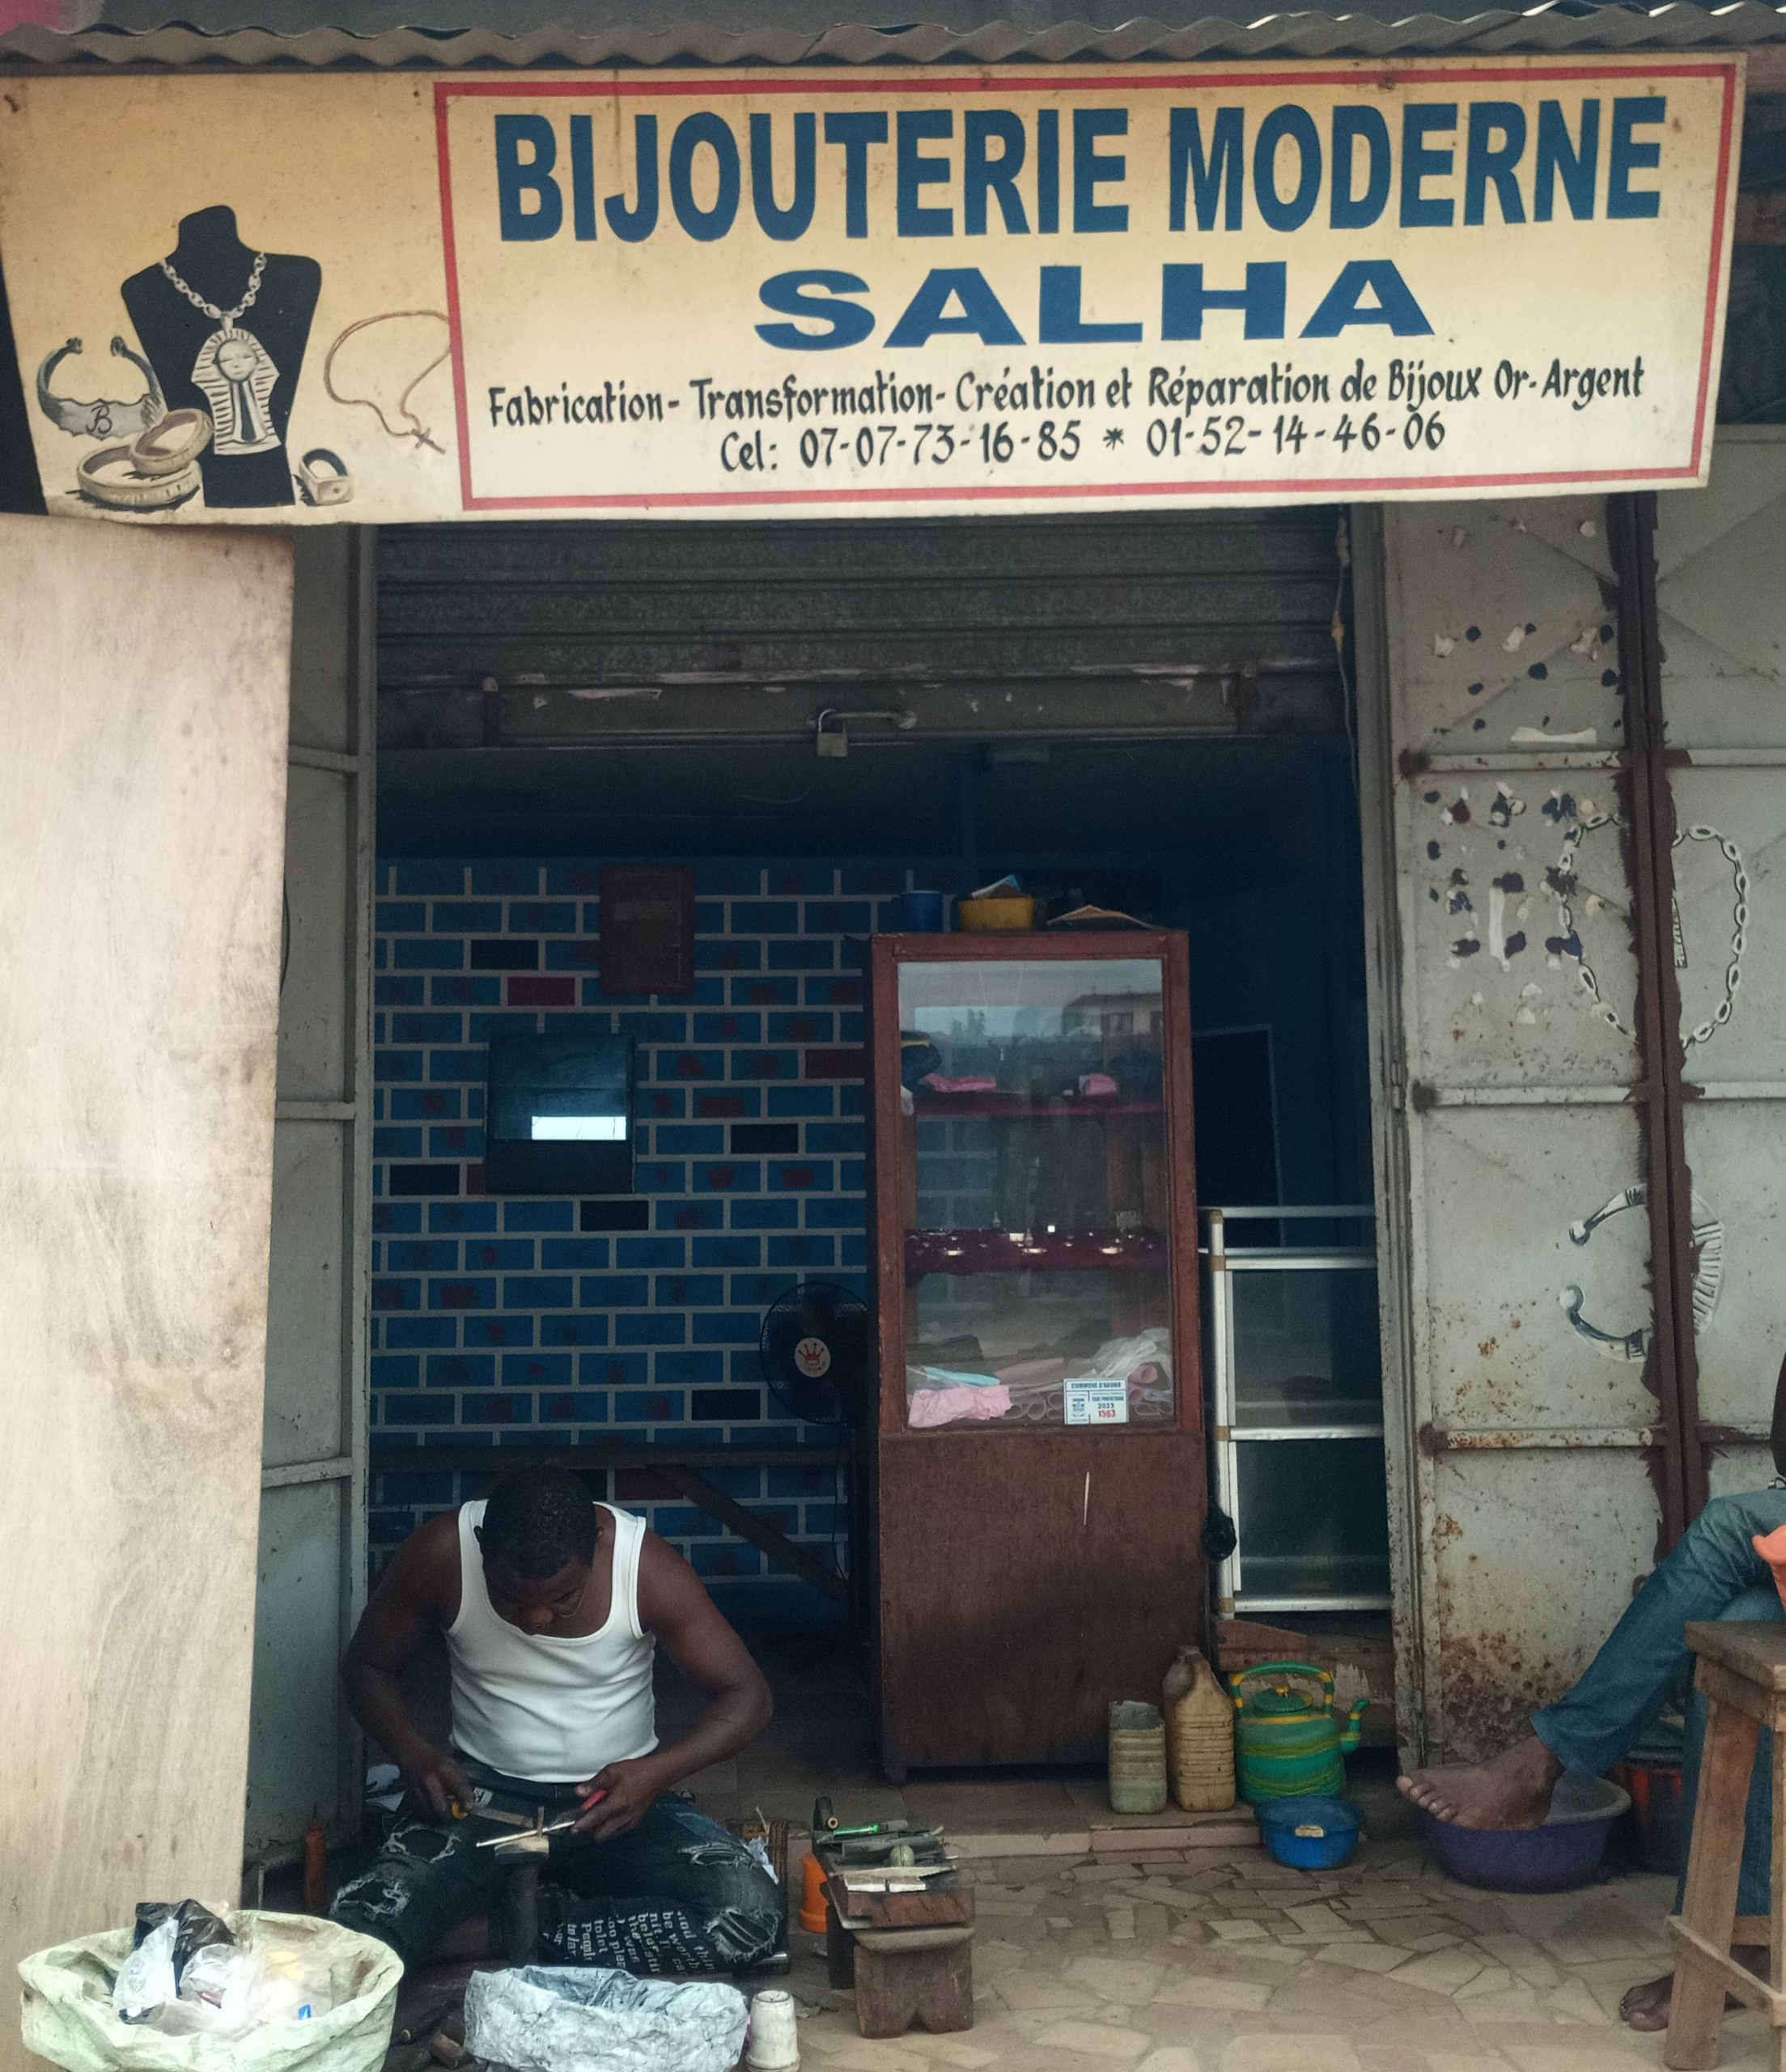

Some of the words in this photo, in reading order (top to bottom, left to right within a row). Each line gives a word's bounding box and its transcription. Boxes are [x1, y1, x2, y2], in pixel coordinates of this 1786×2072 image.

[495, 108, 1128, 242] BIJOUTERIE
[1169, 96, 1666, 231] MODERNE
[754, 259, 1435, 351] SALHA
[956, 367, 1096, 412] Création
[1106, 367, 1133, 408] et
[1148, 363, 1330, 418] Réparation
[1341, 358, 1377, 402] de
[1389, 359, 1482, 412] Bijoux
[720, 430, 778, 472] Cel:
[800, 420, 1081, 468] 07-07-73-16-85
[1147, 411, 1446, 457] 01-52-14-46-06
